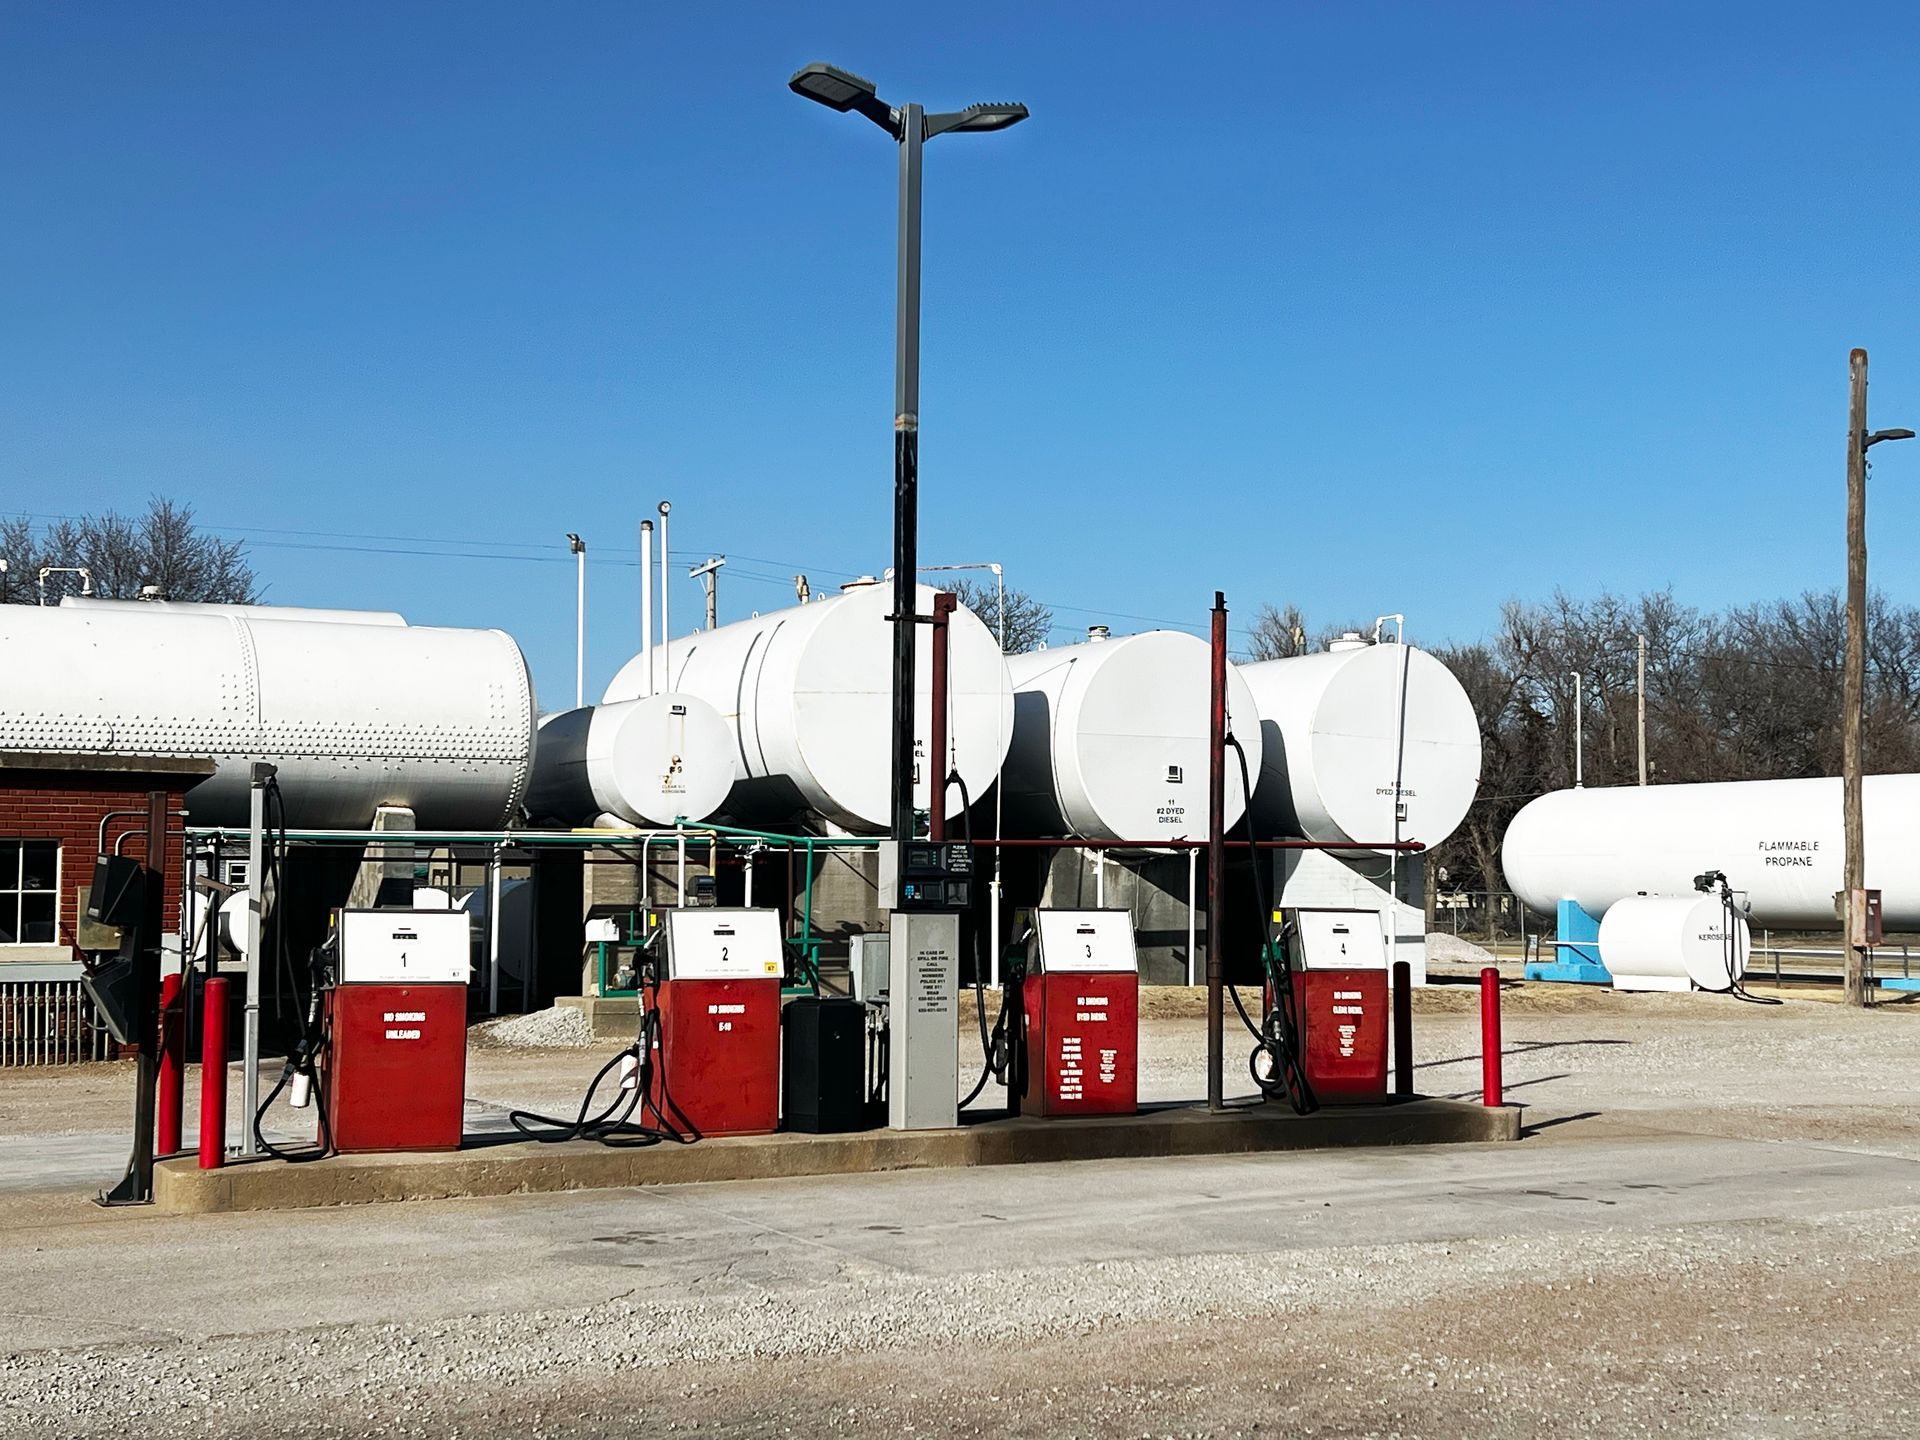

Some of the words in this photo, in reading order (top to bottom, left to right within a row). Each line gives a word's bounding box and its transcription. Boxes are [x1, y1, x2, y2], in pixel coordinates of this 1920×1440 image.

[1159, 816, 1183, 824] DIESEL
[1759, 841, 1820, 851] FLAMMABLE
[1765, 856, 1813, 867] PROPANE
[722, 947, 729, 961] 2
[1086, 944, 1092, 959] 3
[1341, 943, 1347, 956] 4
[401, 952, 407, 968] 1
[1334, 992, 1341, 1000] NO
[1077, 997, 1085, 1006] NO
[1086, 997, 1109, 1006] SMOKING
[708, 1004, 718, 1014] NO
[718, 1004, 745, 1014] SMOKING
[383, 1012, 394, 1022] NO
[394, 1012, 426, 1022] SMOKING
[385, 1030, 421, 1039] UNLEADED
